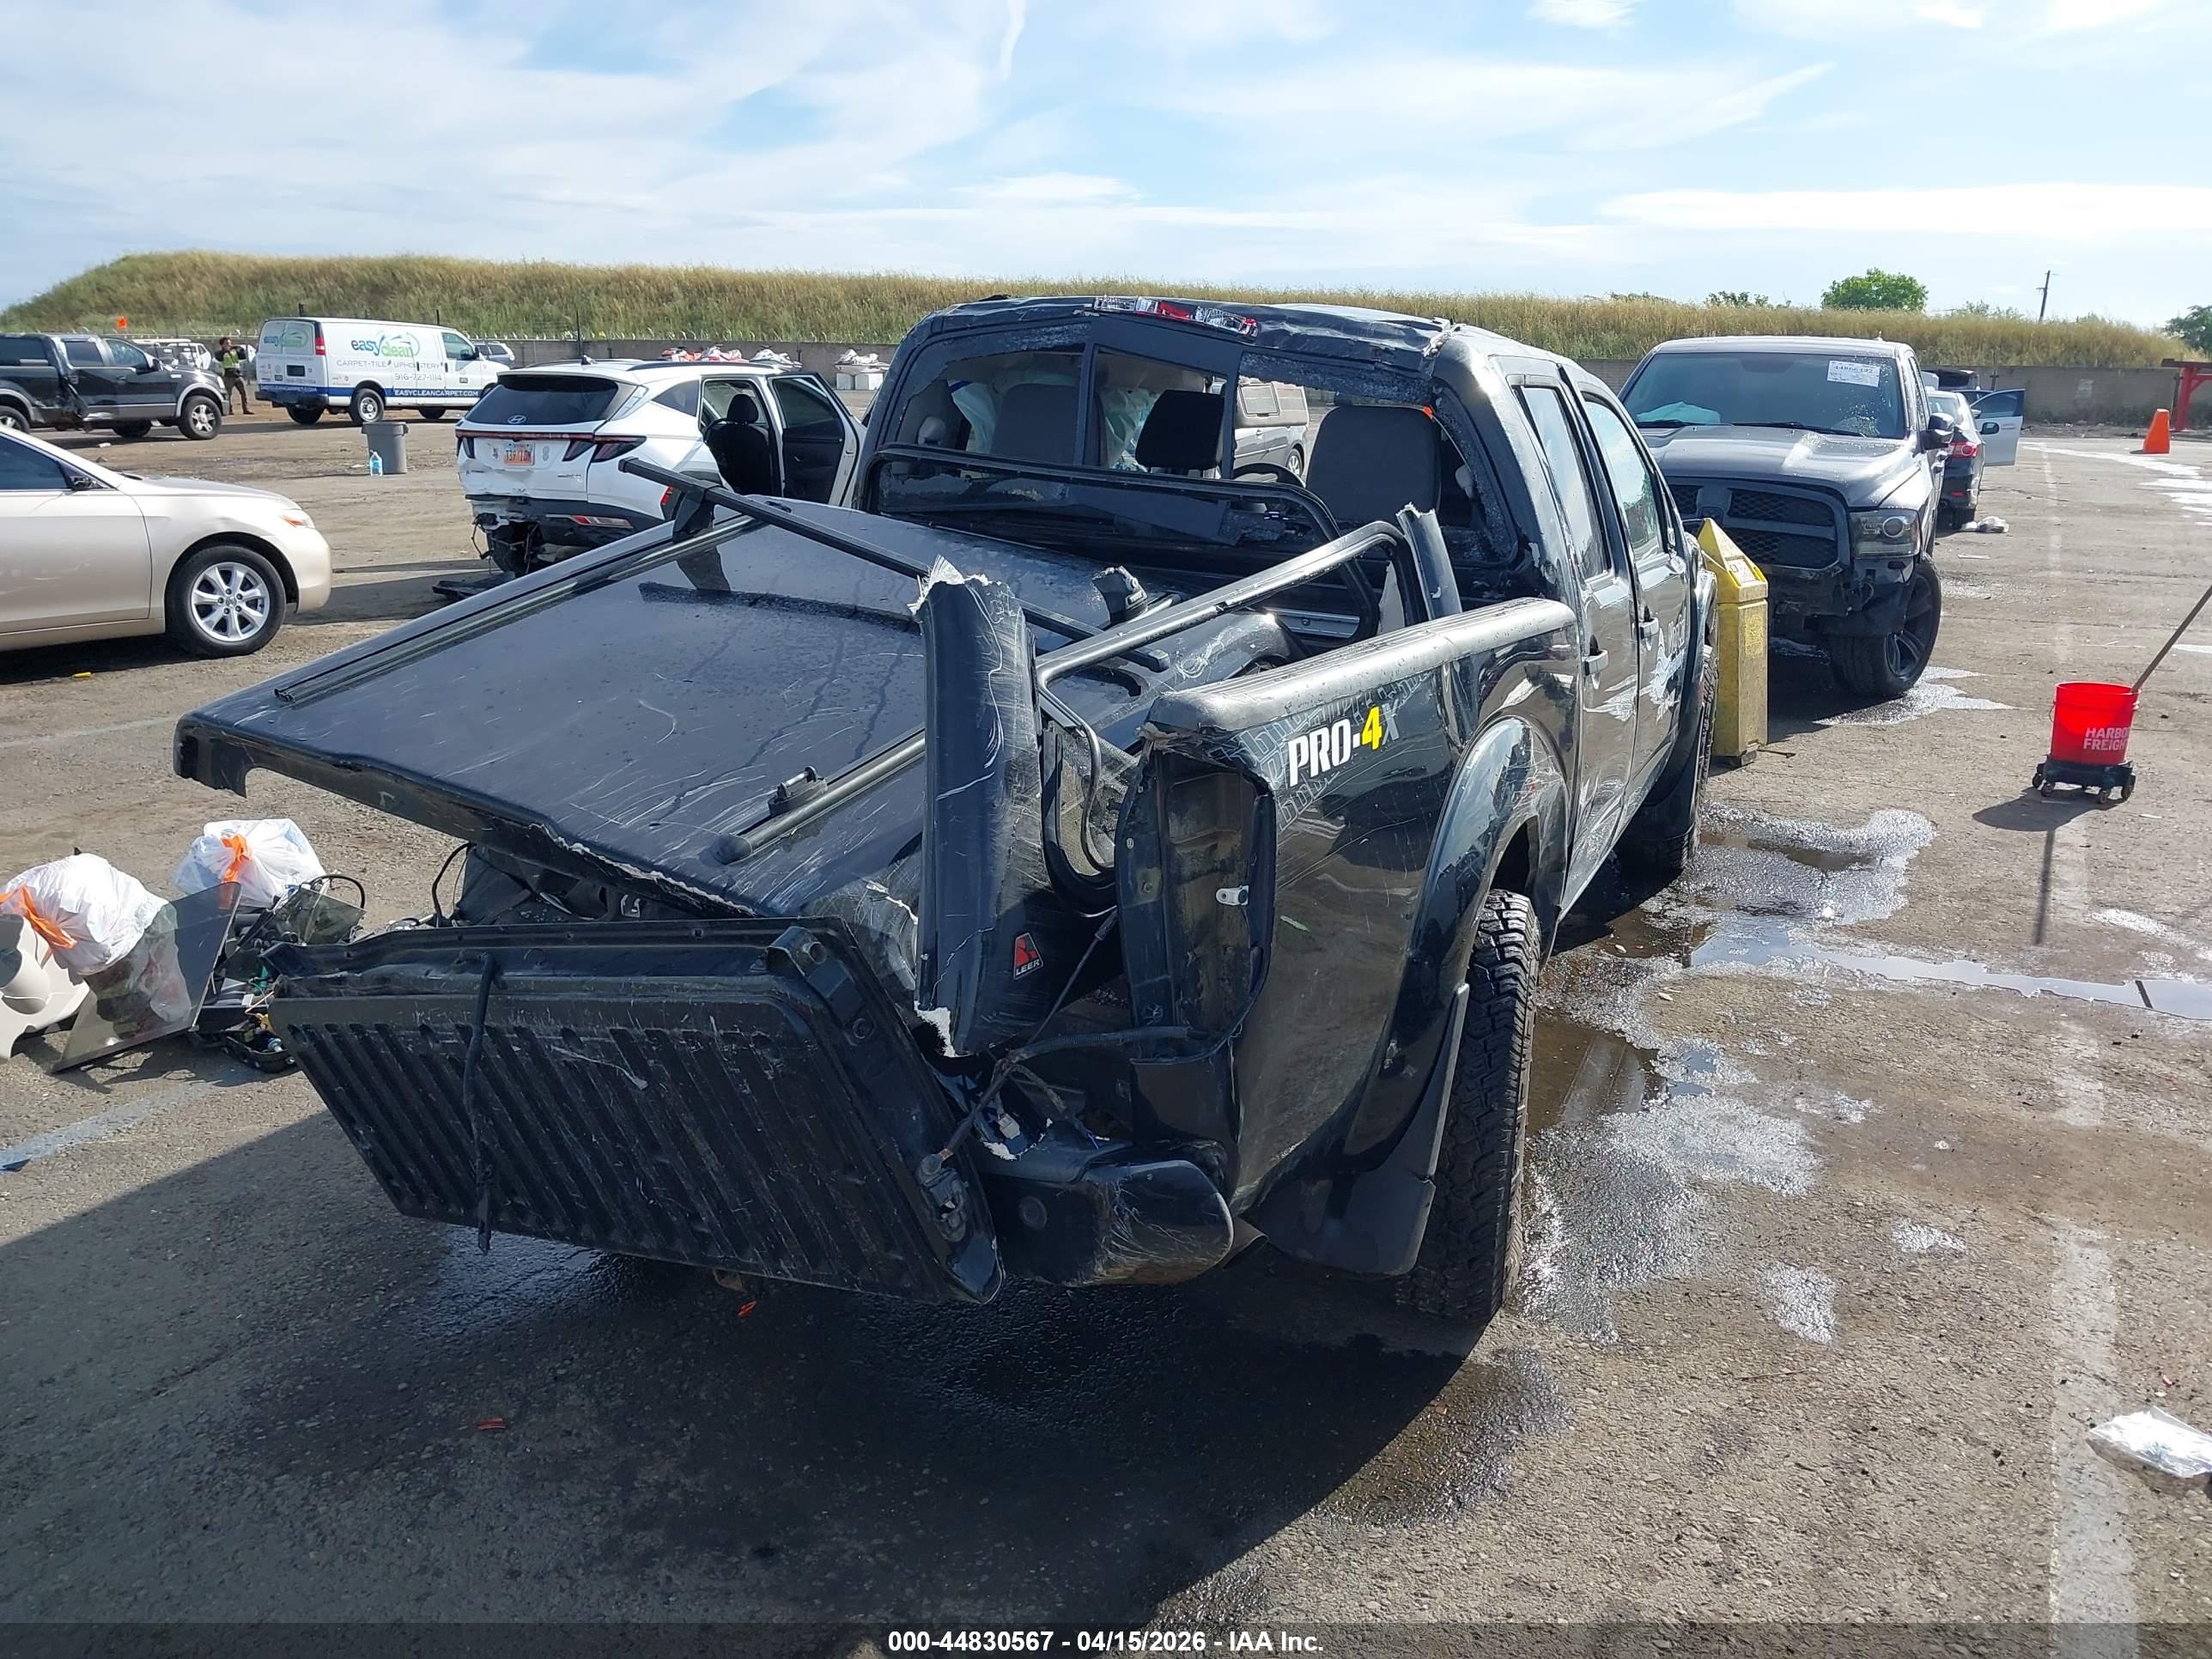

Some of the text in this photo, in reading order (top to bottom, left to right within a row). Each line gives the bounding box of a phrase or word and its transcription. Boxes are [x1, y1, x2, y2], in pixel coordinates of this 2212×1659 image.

[394, 373, 442, 381] 916-727-1114
[394, 388, 479, 397] EASYCLEANCARPET.COM
[2085, 727, 2130, 738] HARBO
[1288, 698, 1400, 787] PRO-4X
[2083, 738, 2128, 750] FREIGH
[1016, 958, 1041, 975] LEER
